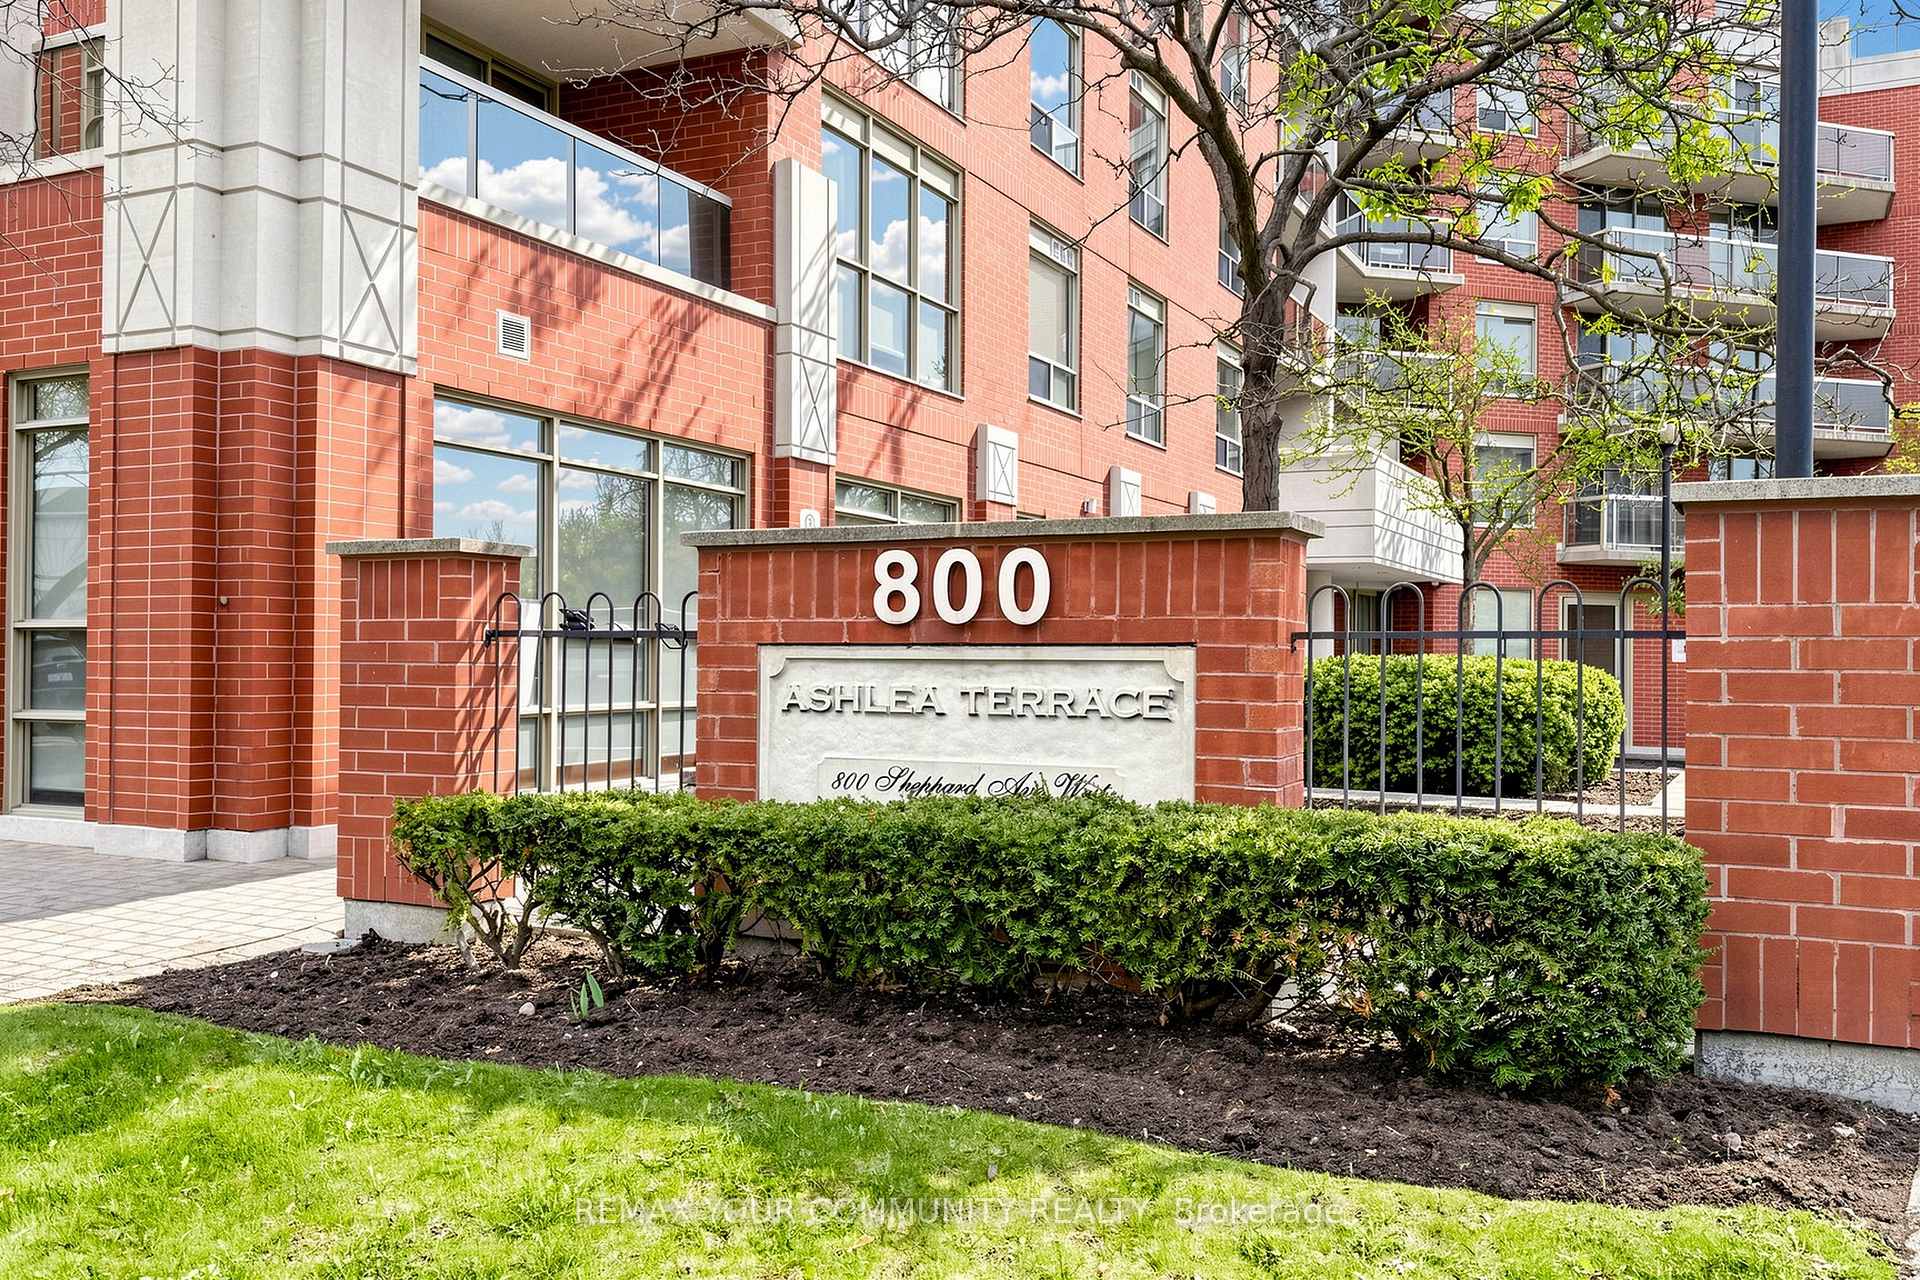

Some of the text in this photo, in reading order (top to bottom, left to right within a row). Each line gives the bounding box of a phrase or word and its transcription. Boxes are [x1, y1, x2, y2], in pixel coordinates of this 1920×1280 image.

[872, 547, 1051, 626] 800
[781, 682, 1175, 722] ASHLEA TERRACE
[831, 771, 870, 791] 800
[874, 765, 986, 797] Sheppard
